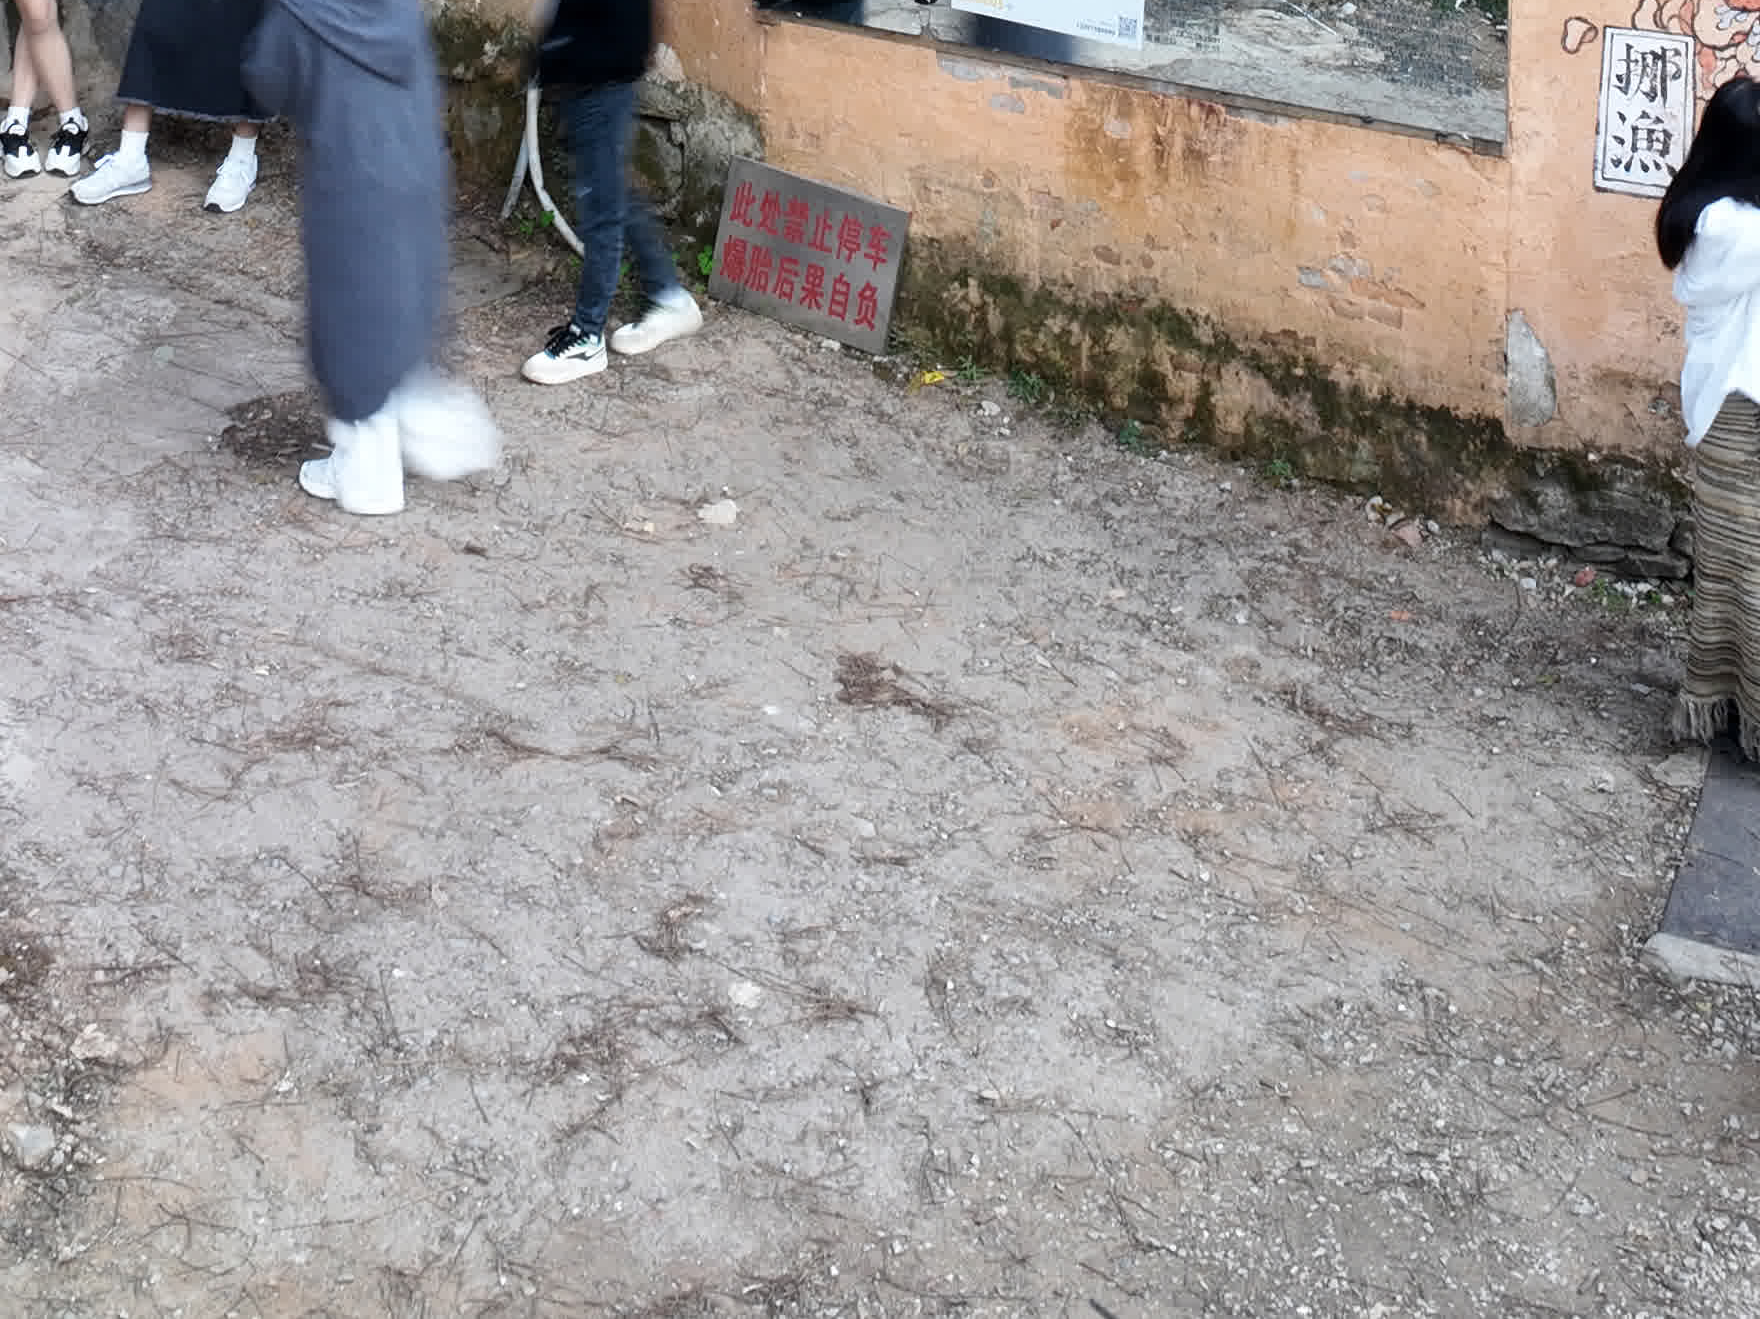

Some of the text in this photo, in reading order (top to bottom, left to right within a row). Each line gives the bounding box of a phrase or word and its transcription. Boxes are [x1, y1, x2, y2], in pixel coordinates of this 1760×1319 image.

[728, 180, 892, 272] 此处禁止停车
[720, 235, 879, 331] 爆胎后果自负
